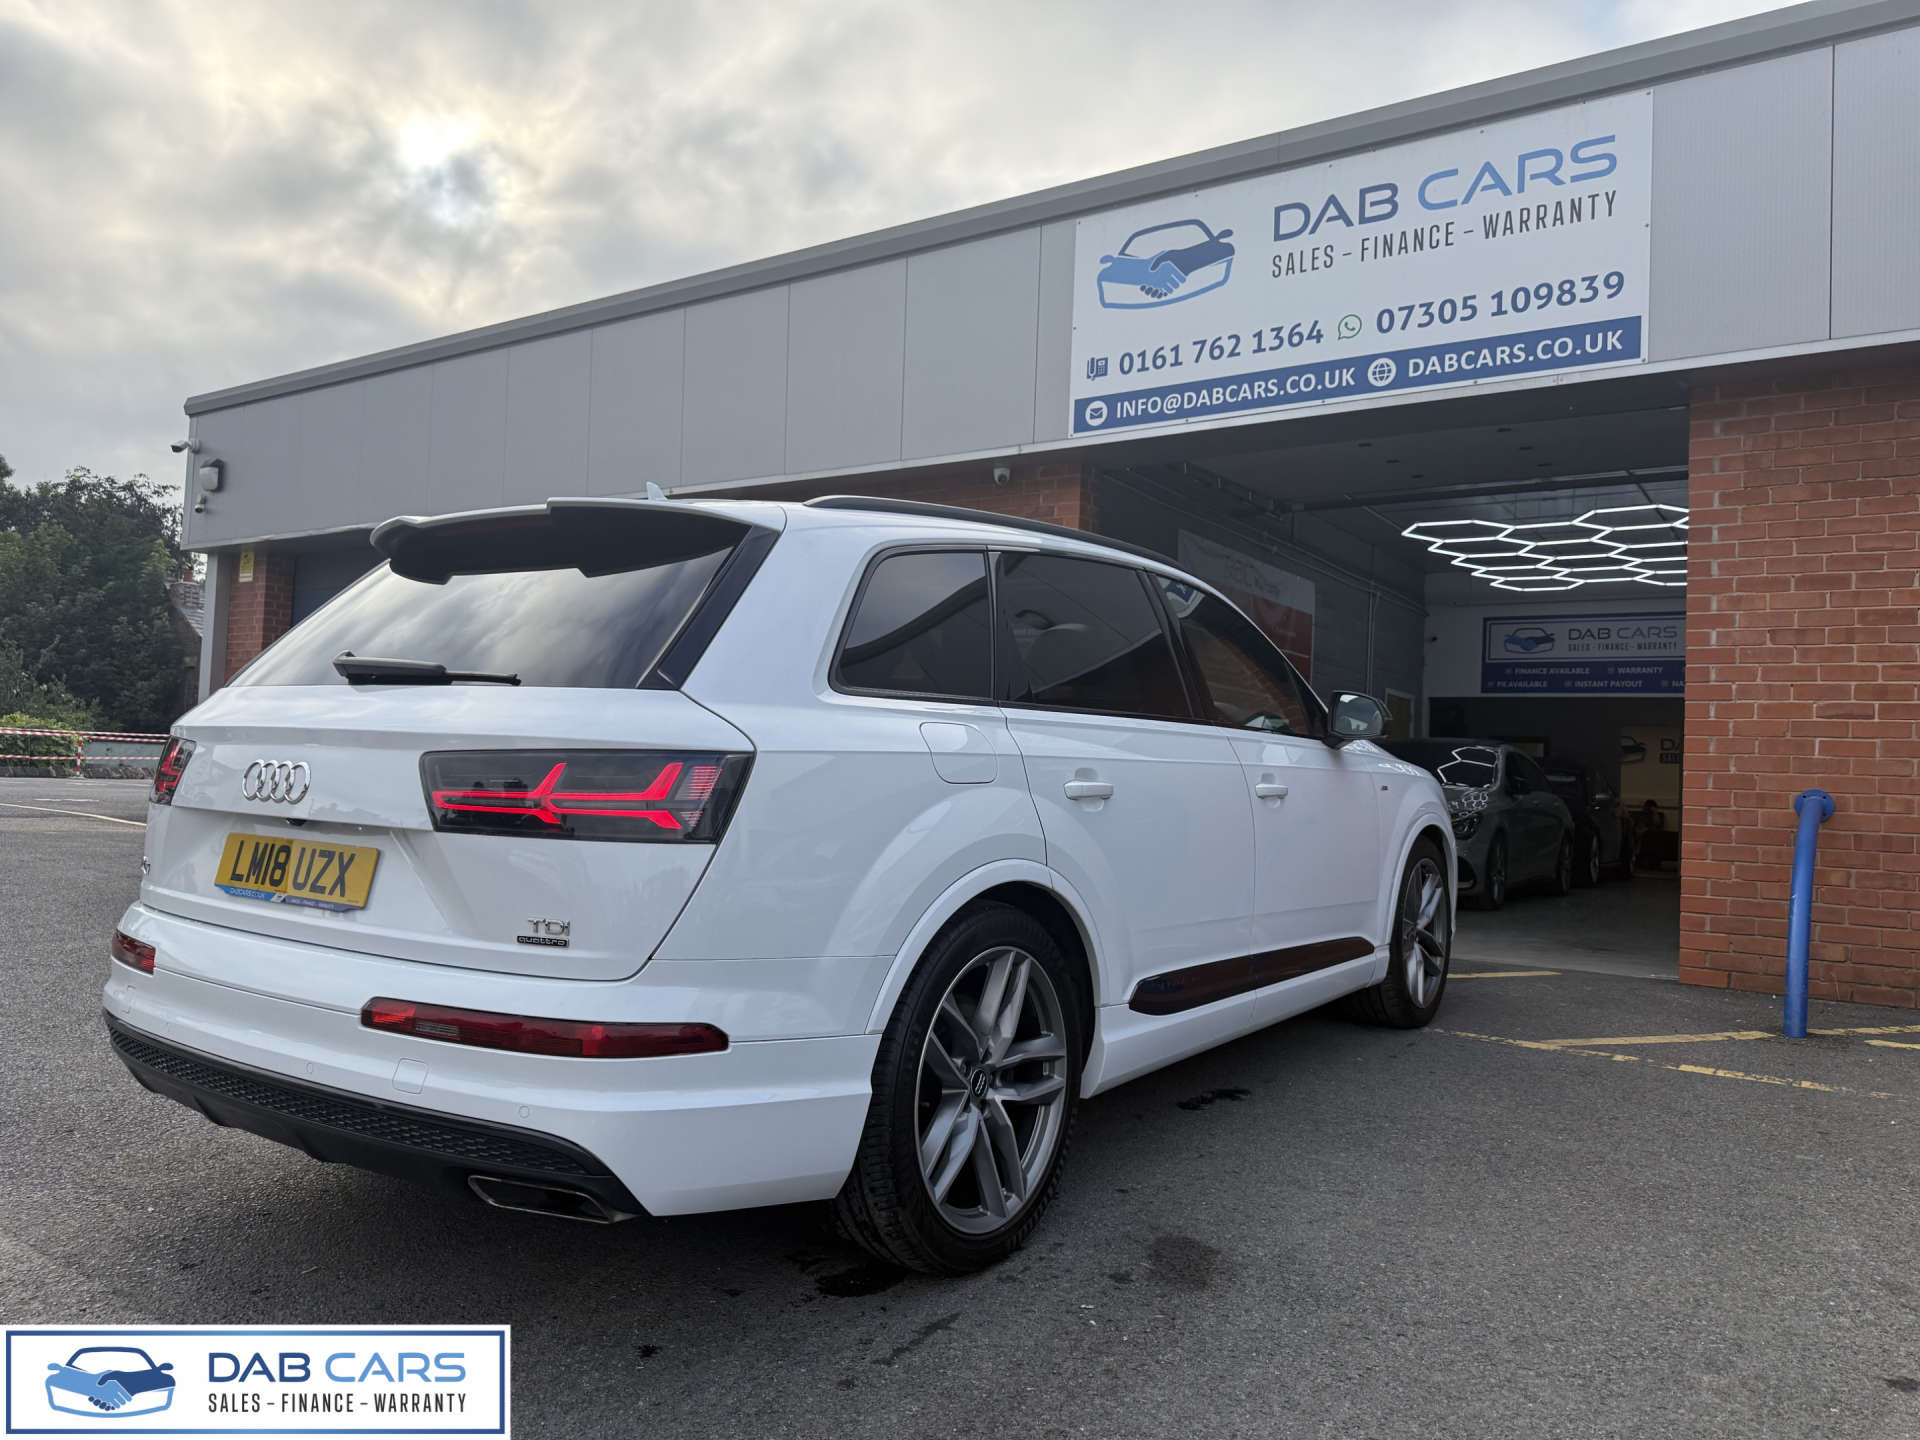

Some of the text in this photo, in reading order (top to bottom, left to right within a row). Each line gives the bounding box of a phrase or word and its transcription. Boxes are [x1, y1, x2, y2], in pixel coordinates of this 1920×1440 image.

[1273, 134, 1618, 242] DAB CARS
[1272, 244, 1335, 278] SALES
[1361, 221, 1455, 262] FINANCE
[1483, 190, 1617, 240] WARRANTY
[1376, 270, 1625, 334] 07305 109839
[1118, 319, 1324, 376] 0161 762 1364
[1408, 329, 1624, 378] DABCARS.CO.UK
[1116, 367, 1356, 419] INFO@DABCARS.CO.UK
[1568, 625, 1678, 641] DAB CARS
[1637, 641, 1677, 651] WARRANTY
[1515, 667, 1590, 675] FINANCE AVAILABLE
[1575, 680, 1643, 688] INSTANT PAYOUT
[1617, 666, 1664, 674] WARRANTY
[230, 839, 356, 898] LM18 UZX
[518, 937, 566, 947] quattro
[528, 918, 570, 936] TDI
